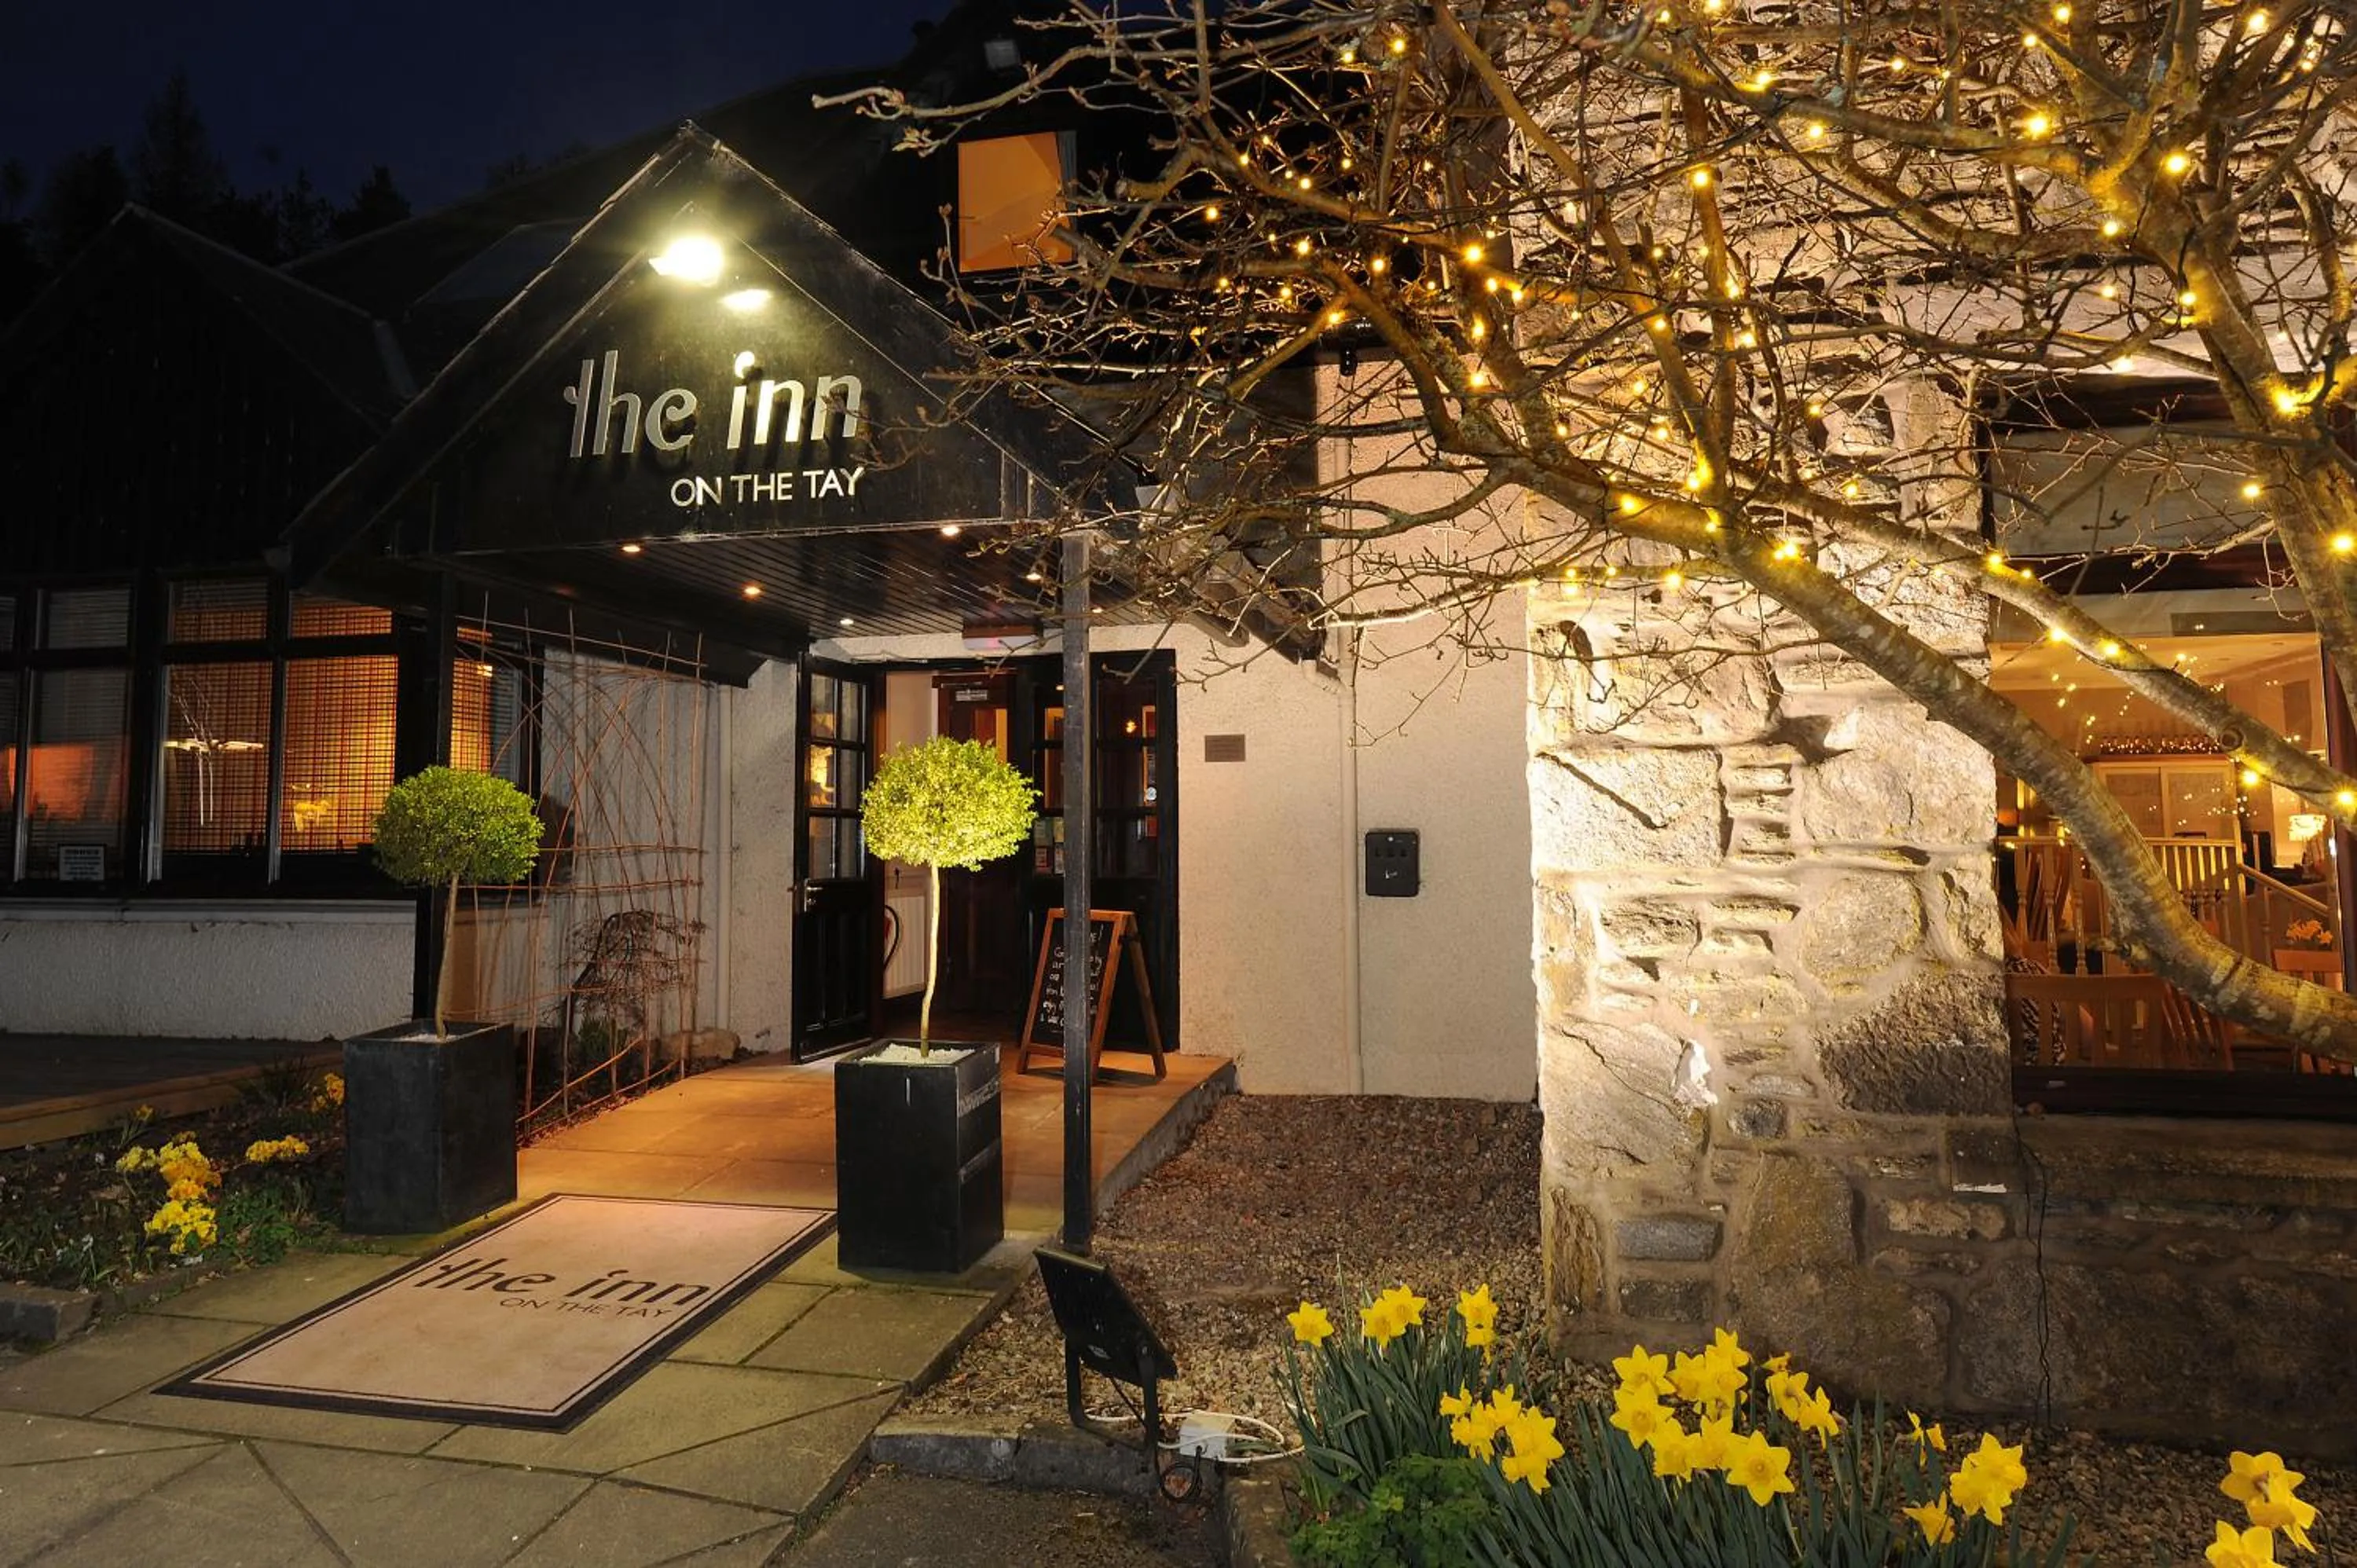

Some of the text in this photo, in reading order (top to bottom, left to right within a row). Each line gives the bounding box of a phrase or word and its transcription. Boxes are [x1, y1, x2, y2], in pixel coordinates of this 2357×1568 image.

[563, 350, 862, 458] the inn
[670, 467, 864, 507] ON THE TAY
[414, 1258, 710, 1306] the inn
[499, 1297, 673, 1318] ON THE TAY
